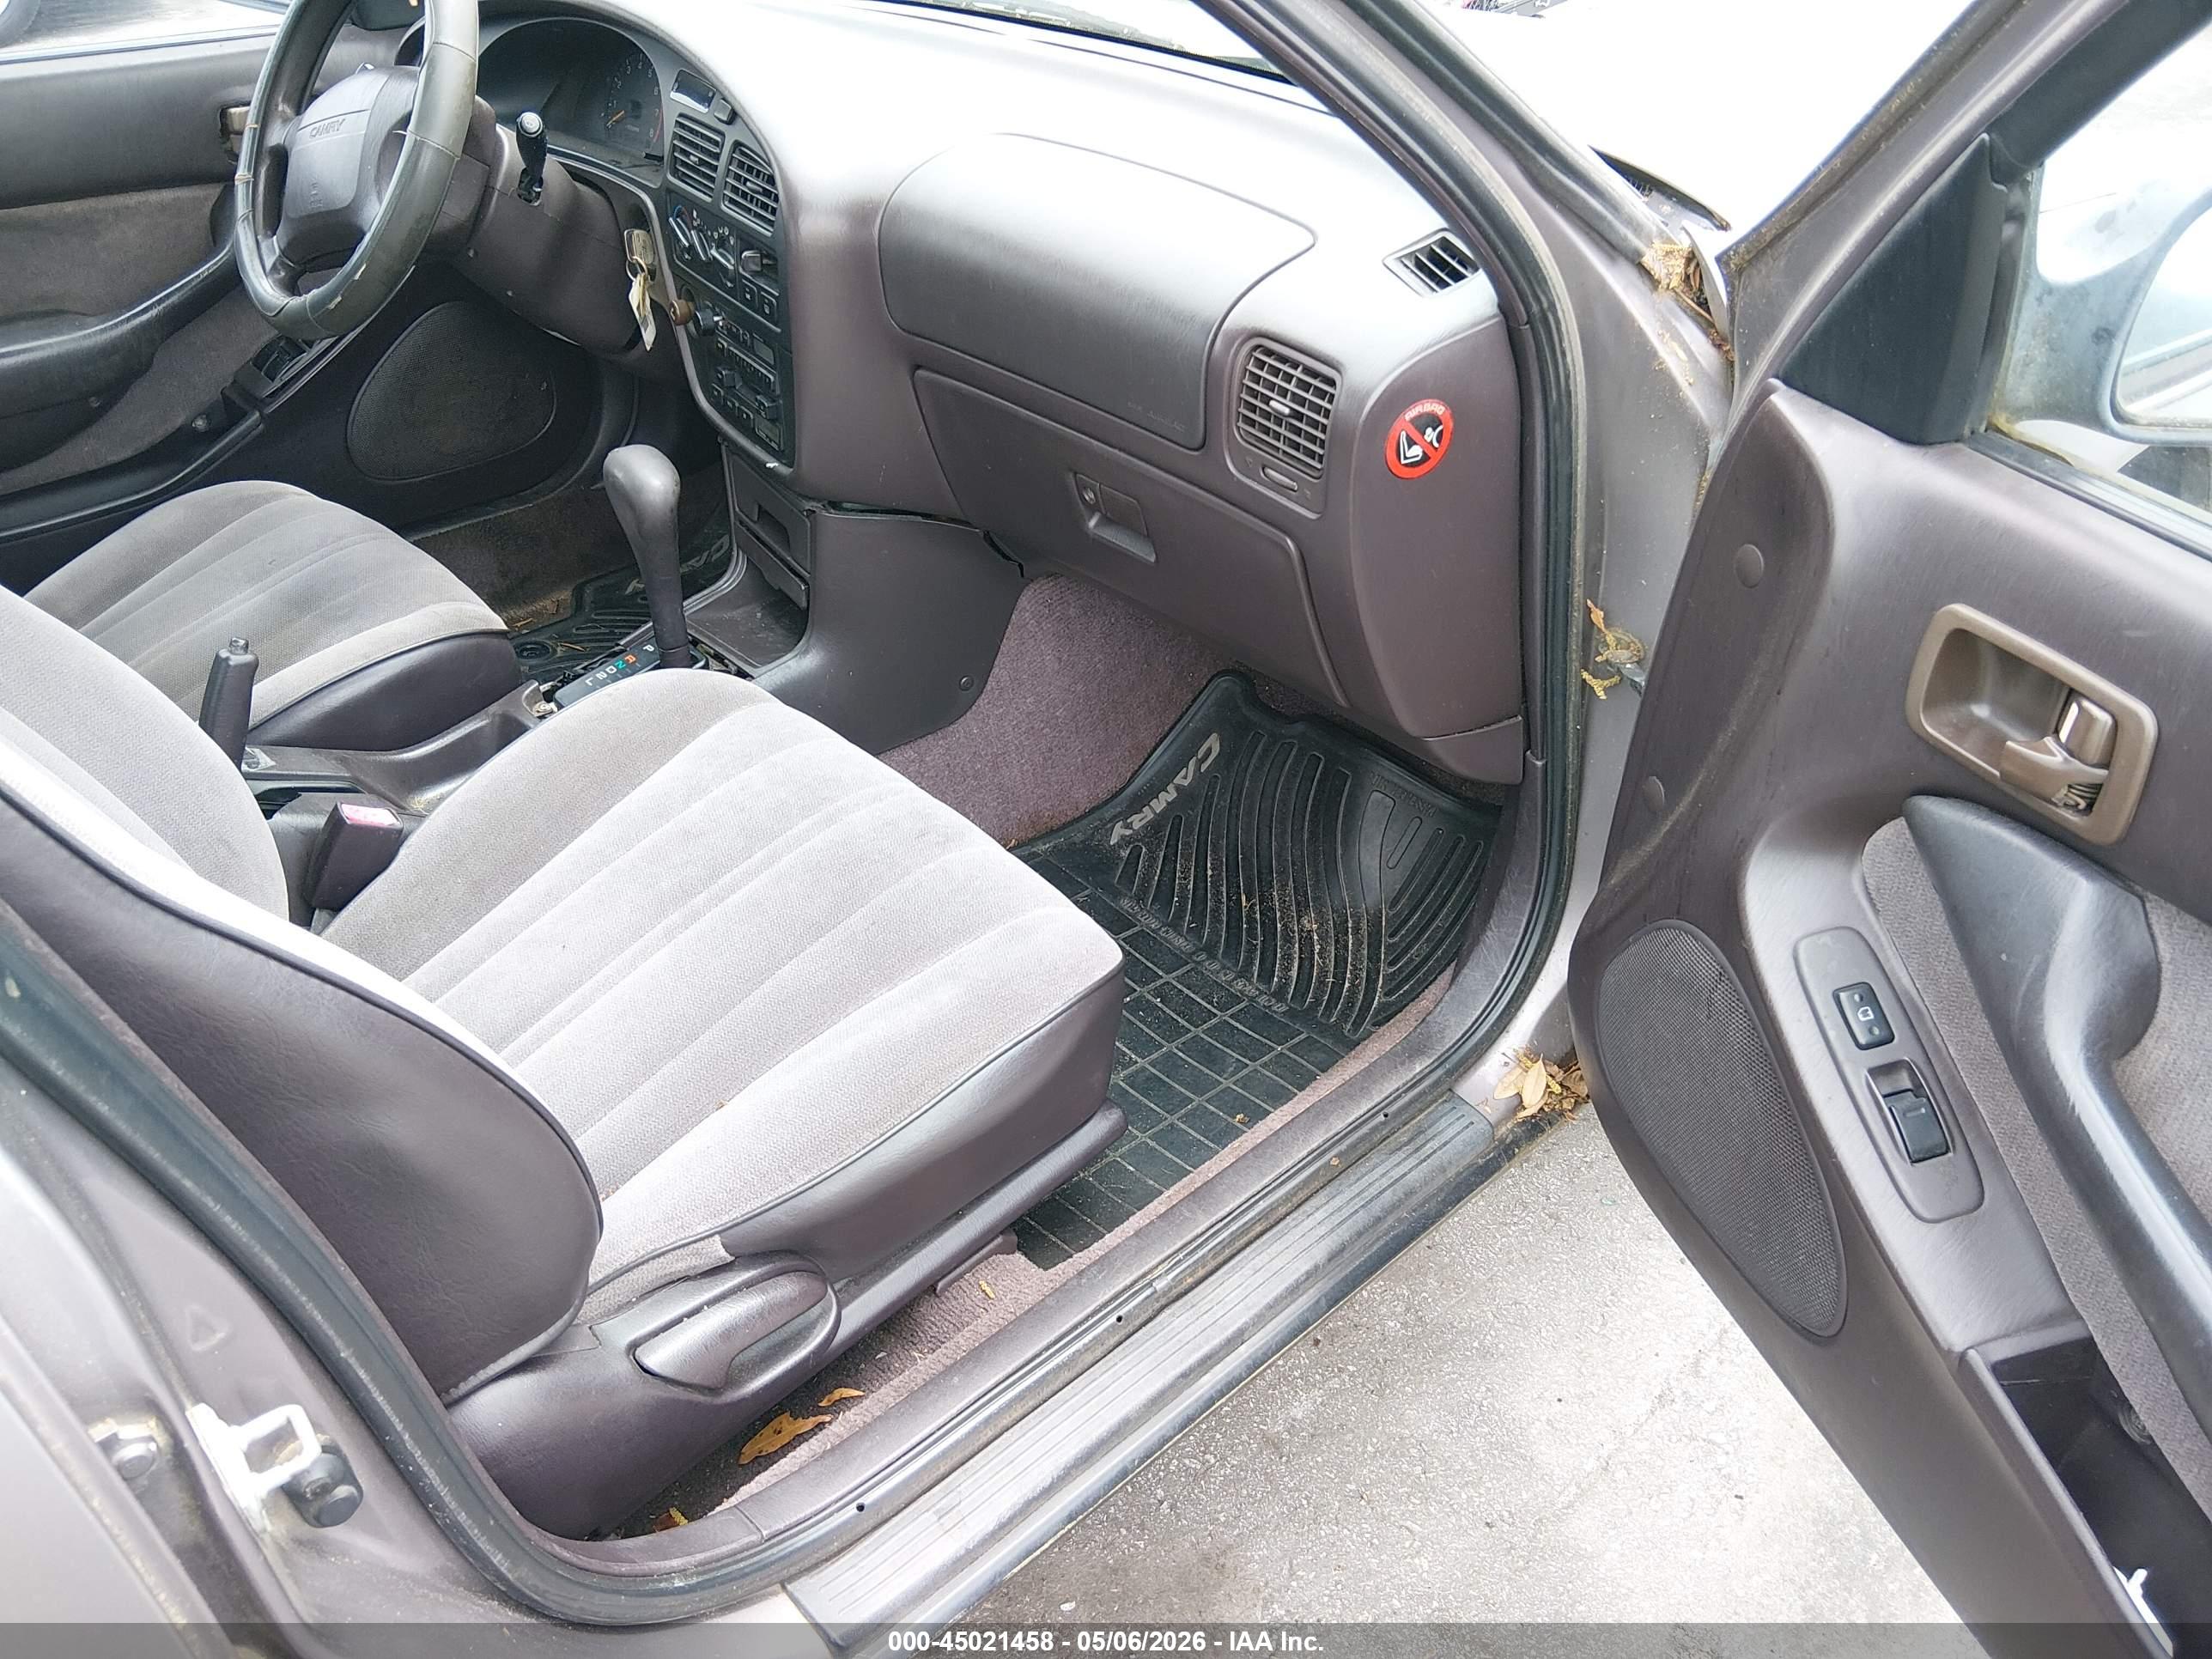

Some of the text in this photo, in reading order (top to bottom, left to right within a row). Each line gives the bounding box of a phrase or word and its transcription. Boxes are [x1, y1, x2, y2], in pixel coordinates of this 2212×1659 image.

[1404, 403, 1445, 422] AIRBAG
[624, 654, 636, 664] R
[585, 677, 593, 686] L
[1110, 732, 1220, 846] CAMRY
